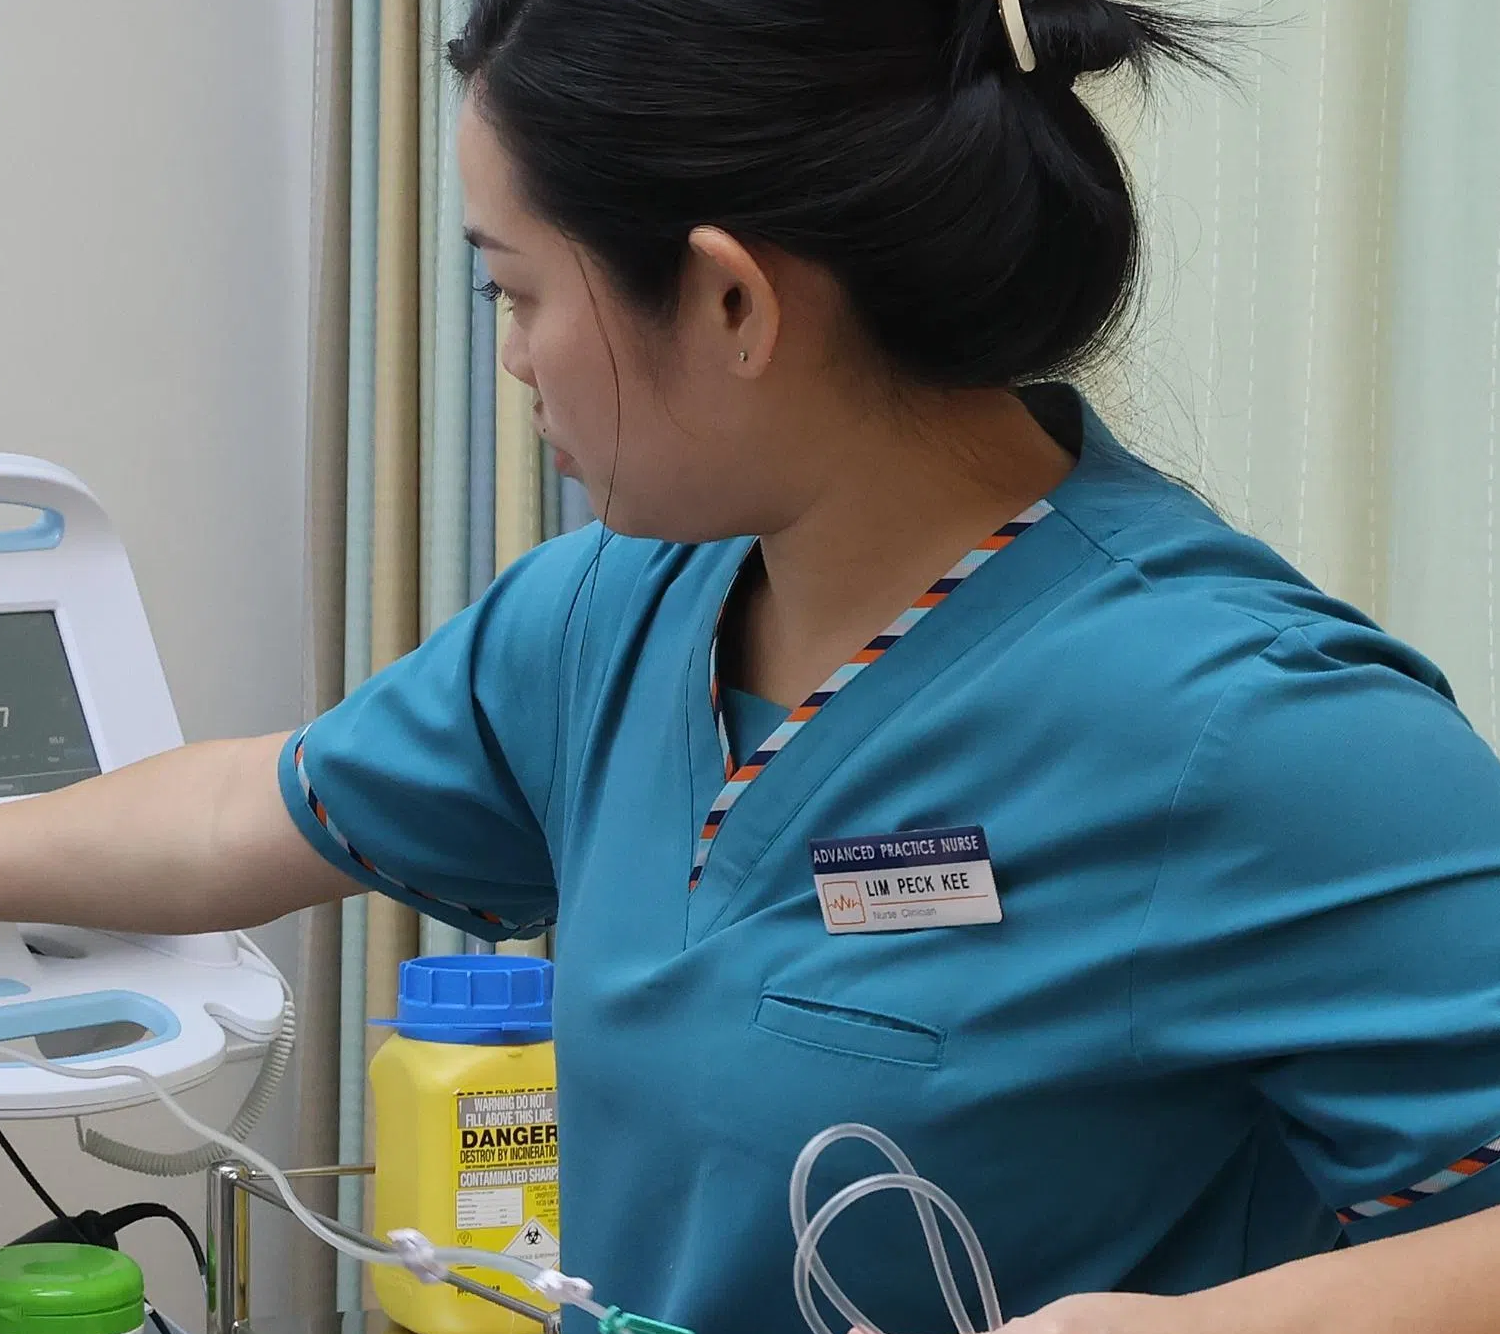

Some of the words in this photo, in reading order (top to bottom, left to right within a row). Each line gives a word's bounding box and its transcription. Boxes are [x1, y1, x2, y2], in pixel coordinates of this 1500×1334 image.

[813, 845, 875, 864] ADVANCED
[880, 839, 936, 858] PRACTICE
[941, 835, 979, 853] NURSE
[865, 880, 890, 897] LIM
[897, 875, 935, 894] PECK
[941, 872, 970, 891] KEE
[872, 910, 897, 920] Nurse
[474, 1095, 514, 1112] WARNING
[516, 1095, 528, 1109] DO
[530, 1094, 546, 1108] NOT
[465, 1113, 484, 1127] FILL
[485, 1111, 513, 1126] ABOVE
[515, 1110, 533, 1124] THIS
[535, 1108, 553, 1123] LINE
[461, 1125, 558, 1148] DANGER
[460, 1149, 496, 1164] DESTROY
[498, 1147, 508, 1161] BY
[510, 1145, 557, 1160] INCINERATIO
[460, 1169, 527, 1186] CONTAMINATED
